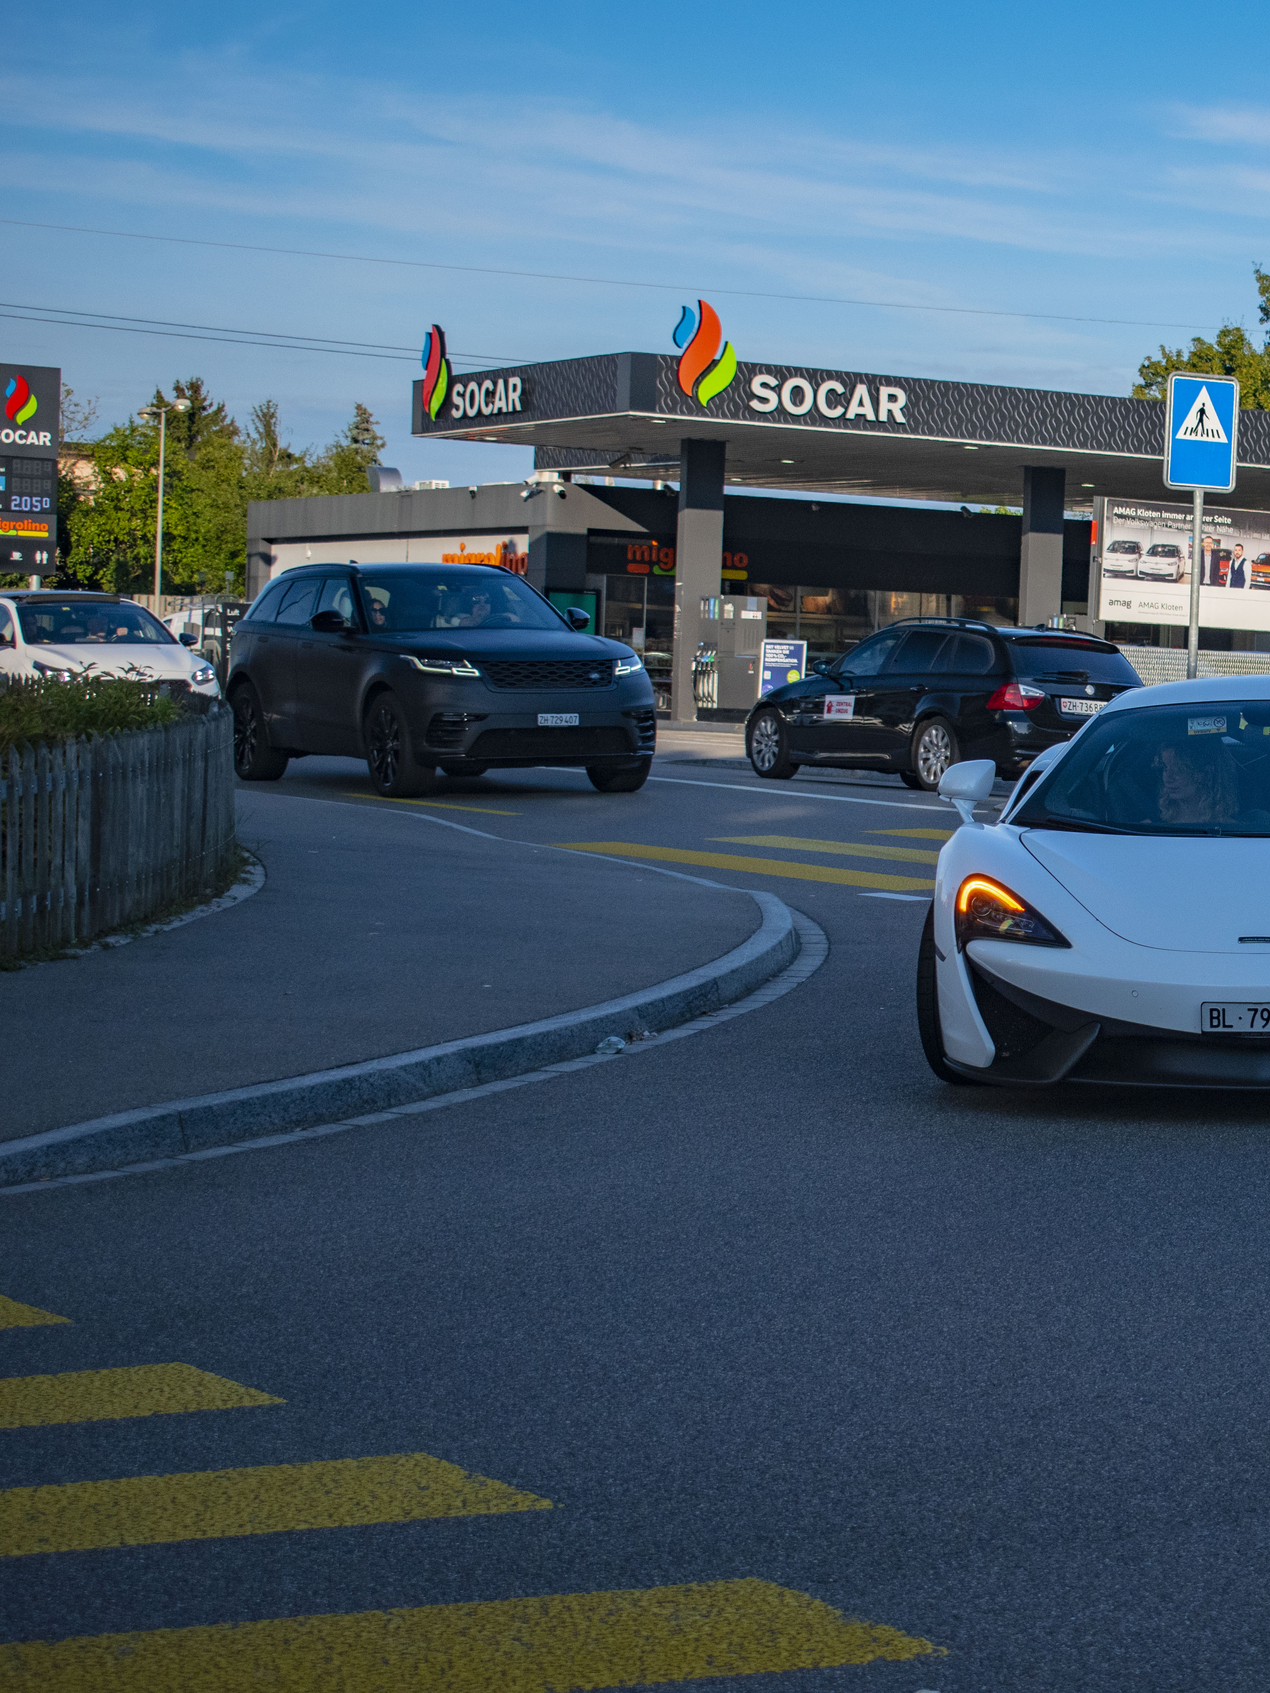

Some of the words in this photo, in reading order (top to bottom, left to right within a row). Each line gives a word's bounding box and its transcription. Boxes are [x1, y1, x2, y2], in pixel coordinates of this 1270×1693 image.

[451, 376, 522, 419] SOCAR
[748, 374, 907, 423] SOCAR
[0, 517, 49, 533] igrolino
[1113, 506, 1137, 516] AMAG
[1137, 508, 1162, 518] Kloten
[1162, 510, 1186, 522] immer
[1213, 515, 1232, 525] Seite
[1127, 517, 1167, 530] Volkswagen
[627, 540, 749, 570] migno
[1108, 599, 1132, 609] amag
[1138, 600, 1160, 610] AMAG
[1161, 603, 1184, 612] Kloten
